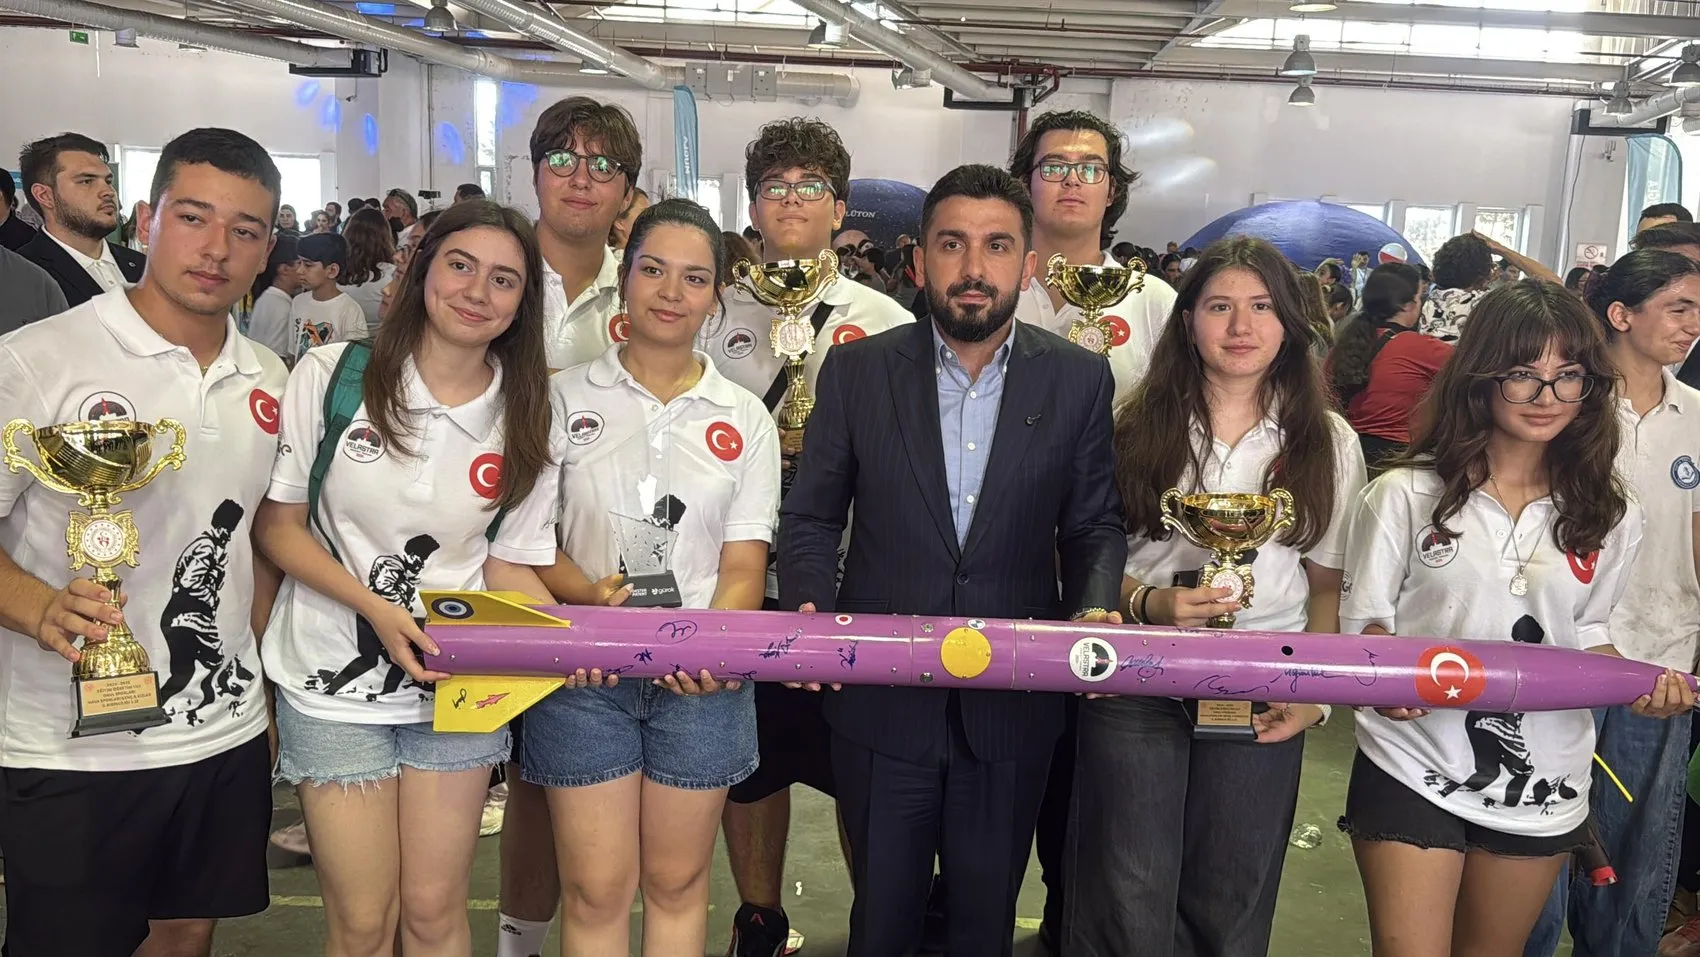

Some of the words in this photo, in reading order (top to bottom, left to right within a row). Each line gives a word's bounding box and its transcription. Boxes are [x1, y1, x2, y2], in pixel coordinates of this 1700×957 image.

[845, 209, 876, 218] LÜTON
[346, 441, 379, 455] VELASTRA
[1423, 547, 1453, 559] VELASTRA
[1082, 642, 1090, 676] VELASTRA
